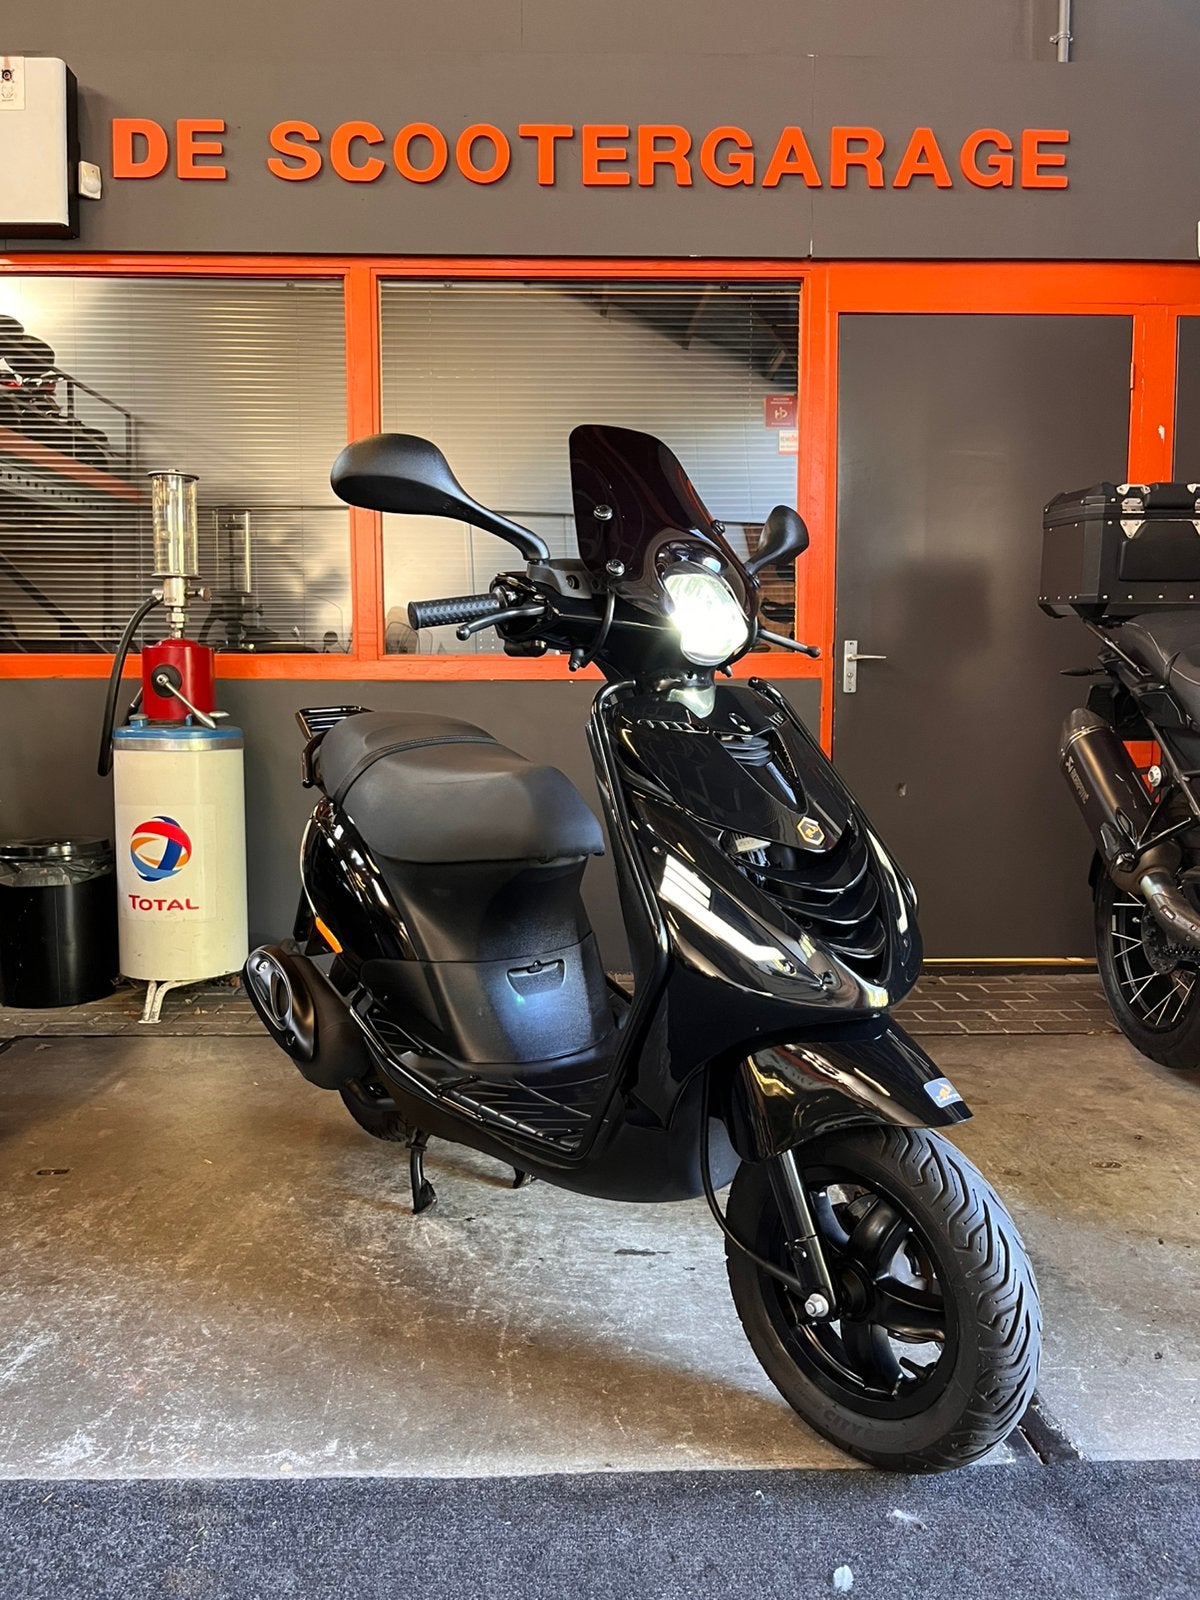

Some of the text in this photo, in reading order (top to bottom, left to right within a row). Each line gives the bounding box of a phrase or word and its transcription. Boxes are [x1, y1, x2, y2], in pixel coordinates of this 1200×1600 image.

[112, 119, 1070, 189] DE SCOOTERGARAGE
[128, 894, 199, 911] TOTAL
